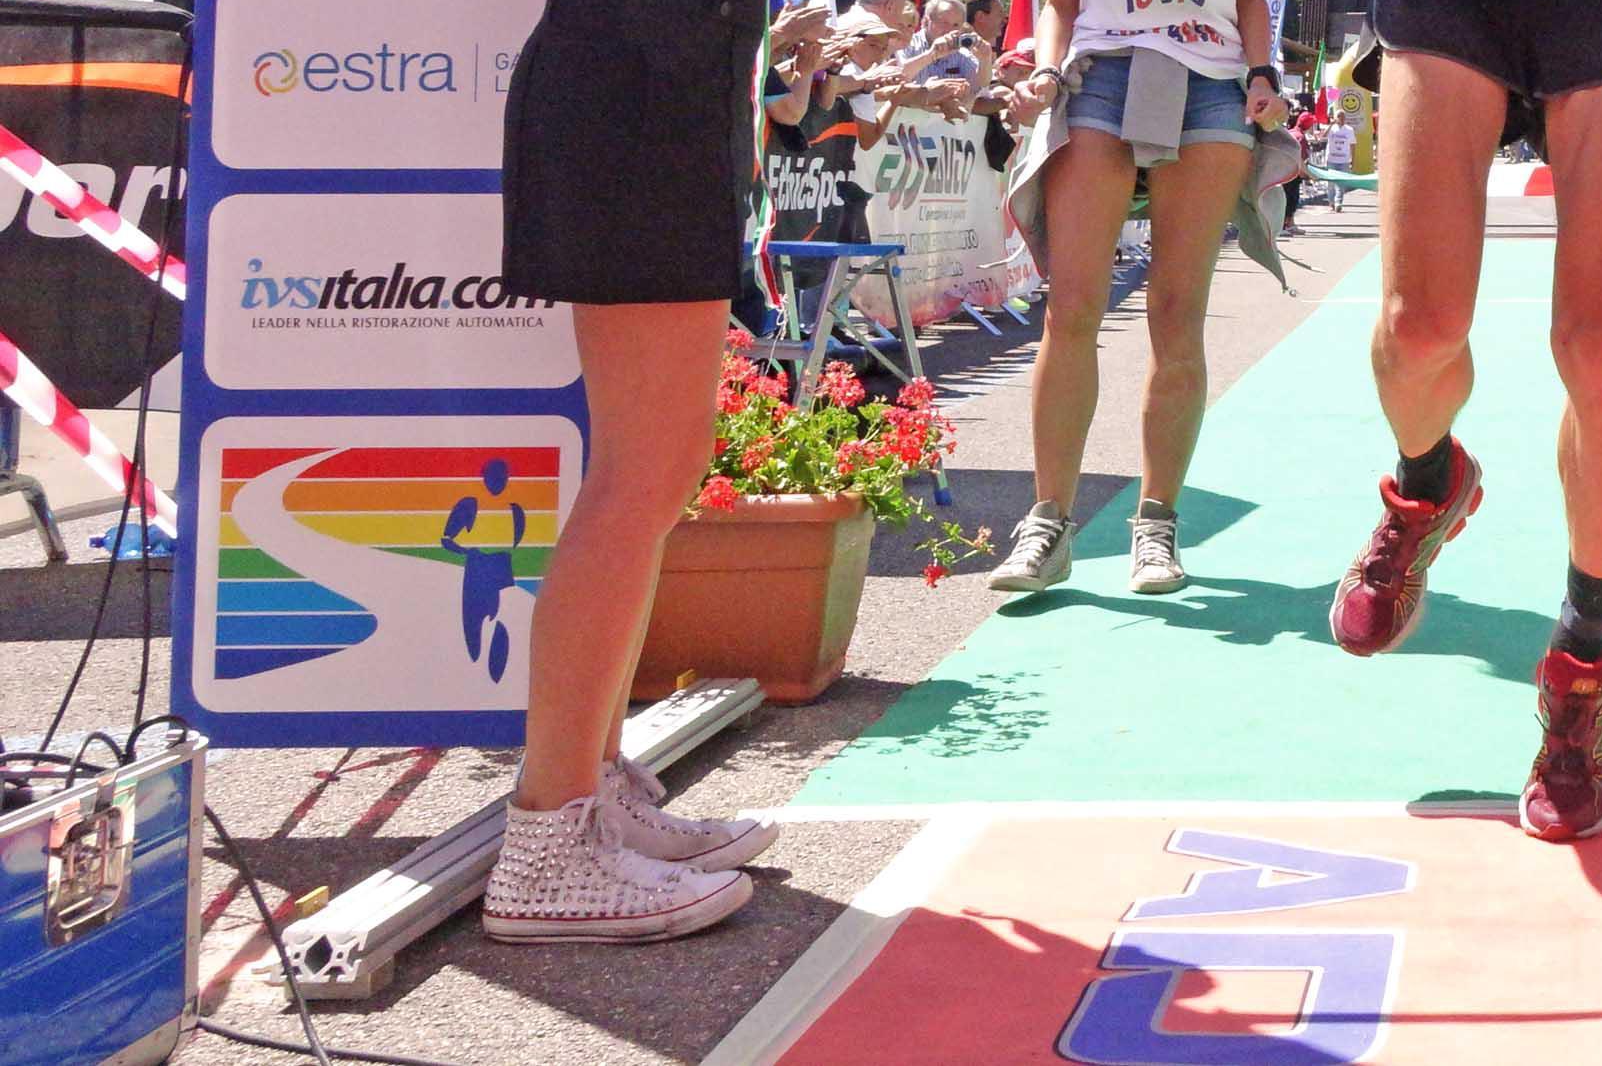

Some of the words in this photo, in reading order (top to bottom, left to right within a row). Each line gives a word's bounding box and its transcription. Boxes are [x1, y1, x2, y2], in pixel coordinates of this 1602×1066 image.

[303, 43, 457, 92] estra
[241, 258, 555, 310] ivsitalia.co
[252, 316, 301, 328] LEADER
[306, 316, 347, 328] NELLA
[351, 317, 450, 329] RISTORAZIONE
[456, 317, 545, 328] AUTOMATICA
